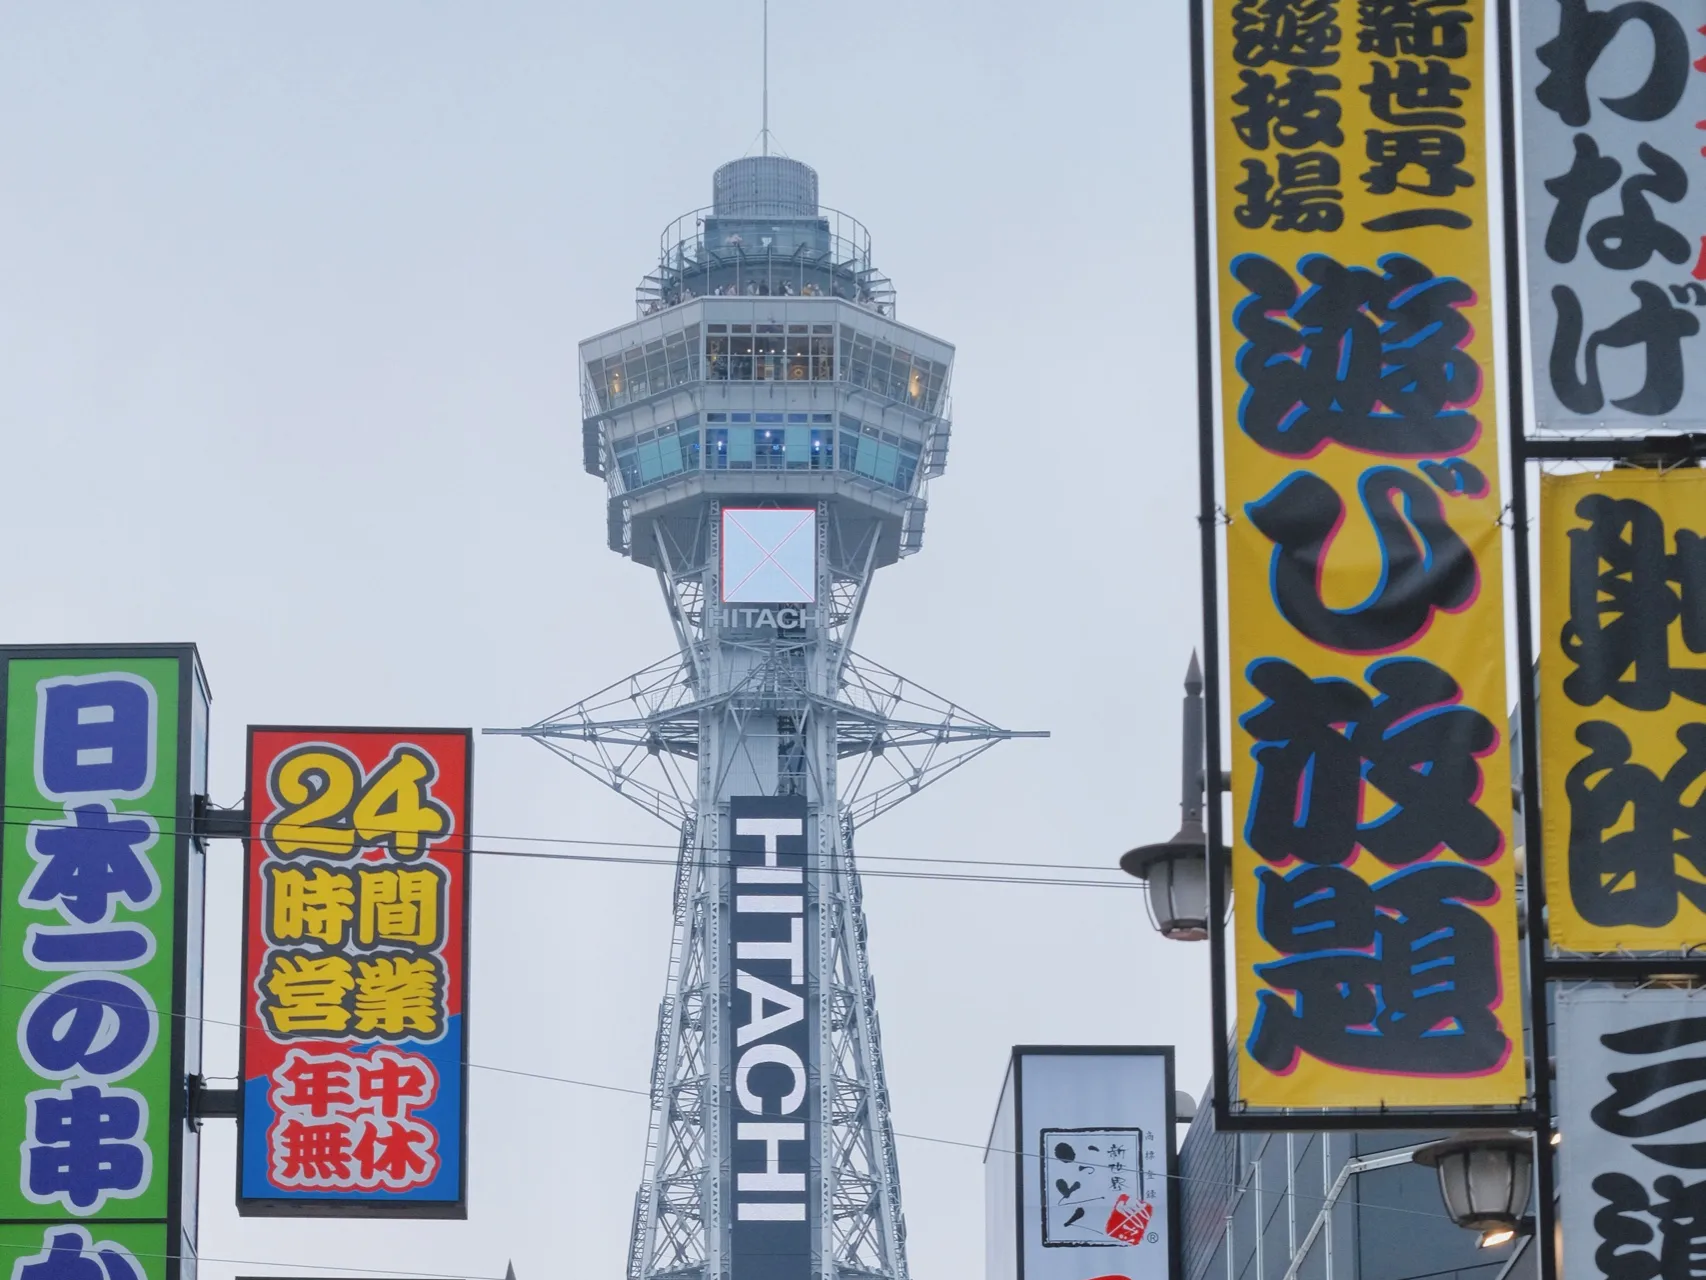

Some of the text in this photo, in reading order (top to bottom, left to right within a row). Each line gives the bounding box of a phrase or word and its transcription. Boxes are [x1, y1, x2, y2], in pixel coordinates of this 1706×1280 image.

[1230, 0, 1345, 232] 遊技場
[1535, 0, 1706, 416] わなげ
[707, 607, 829, 631] HITACHI
[1230, 252, 1512, 1077] 遊び放題
[268, 744, 448, 860] 24
[265, 862, 447, 948] 時間
[261, 952, 443, 1038] 営業
[736, 818, 806, 1222] HITACHI
[271, 1055, 432, 1119] 年中
[275, 1119, 432, 1182] 無休
